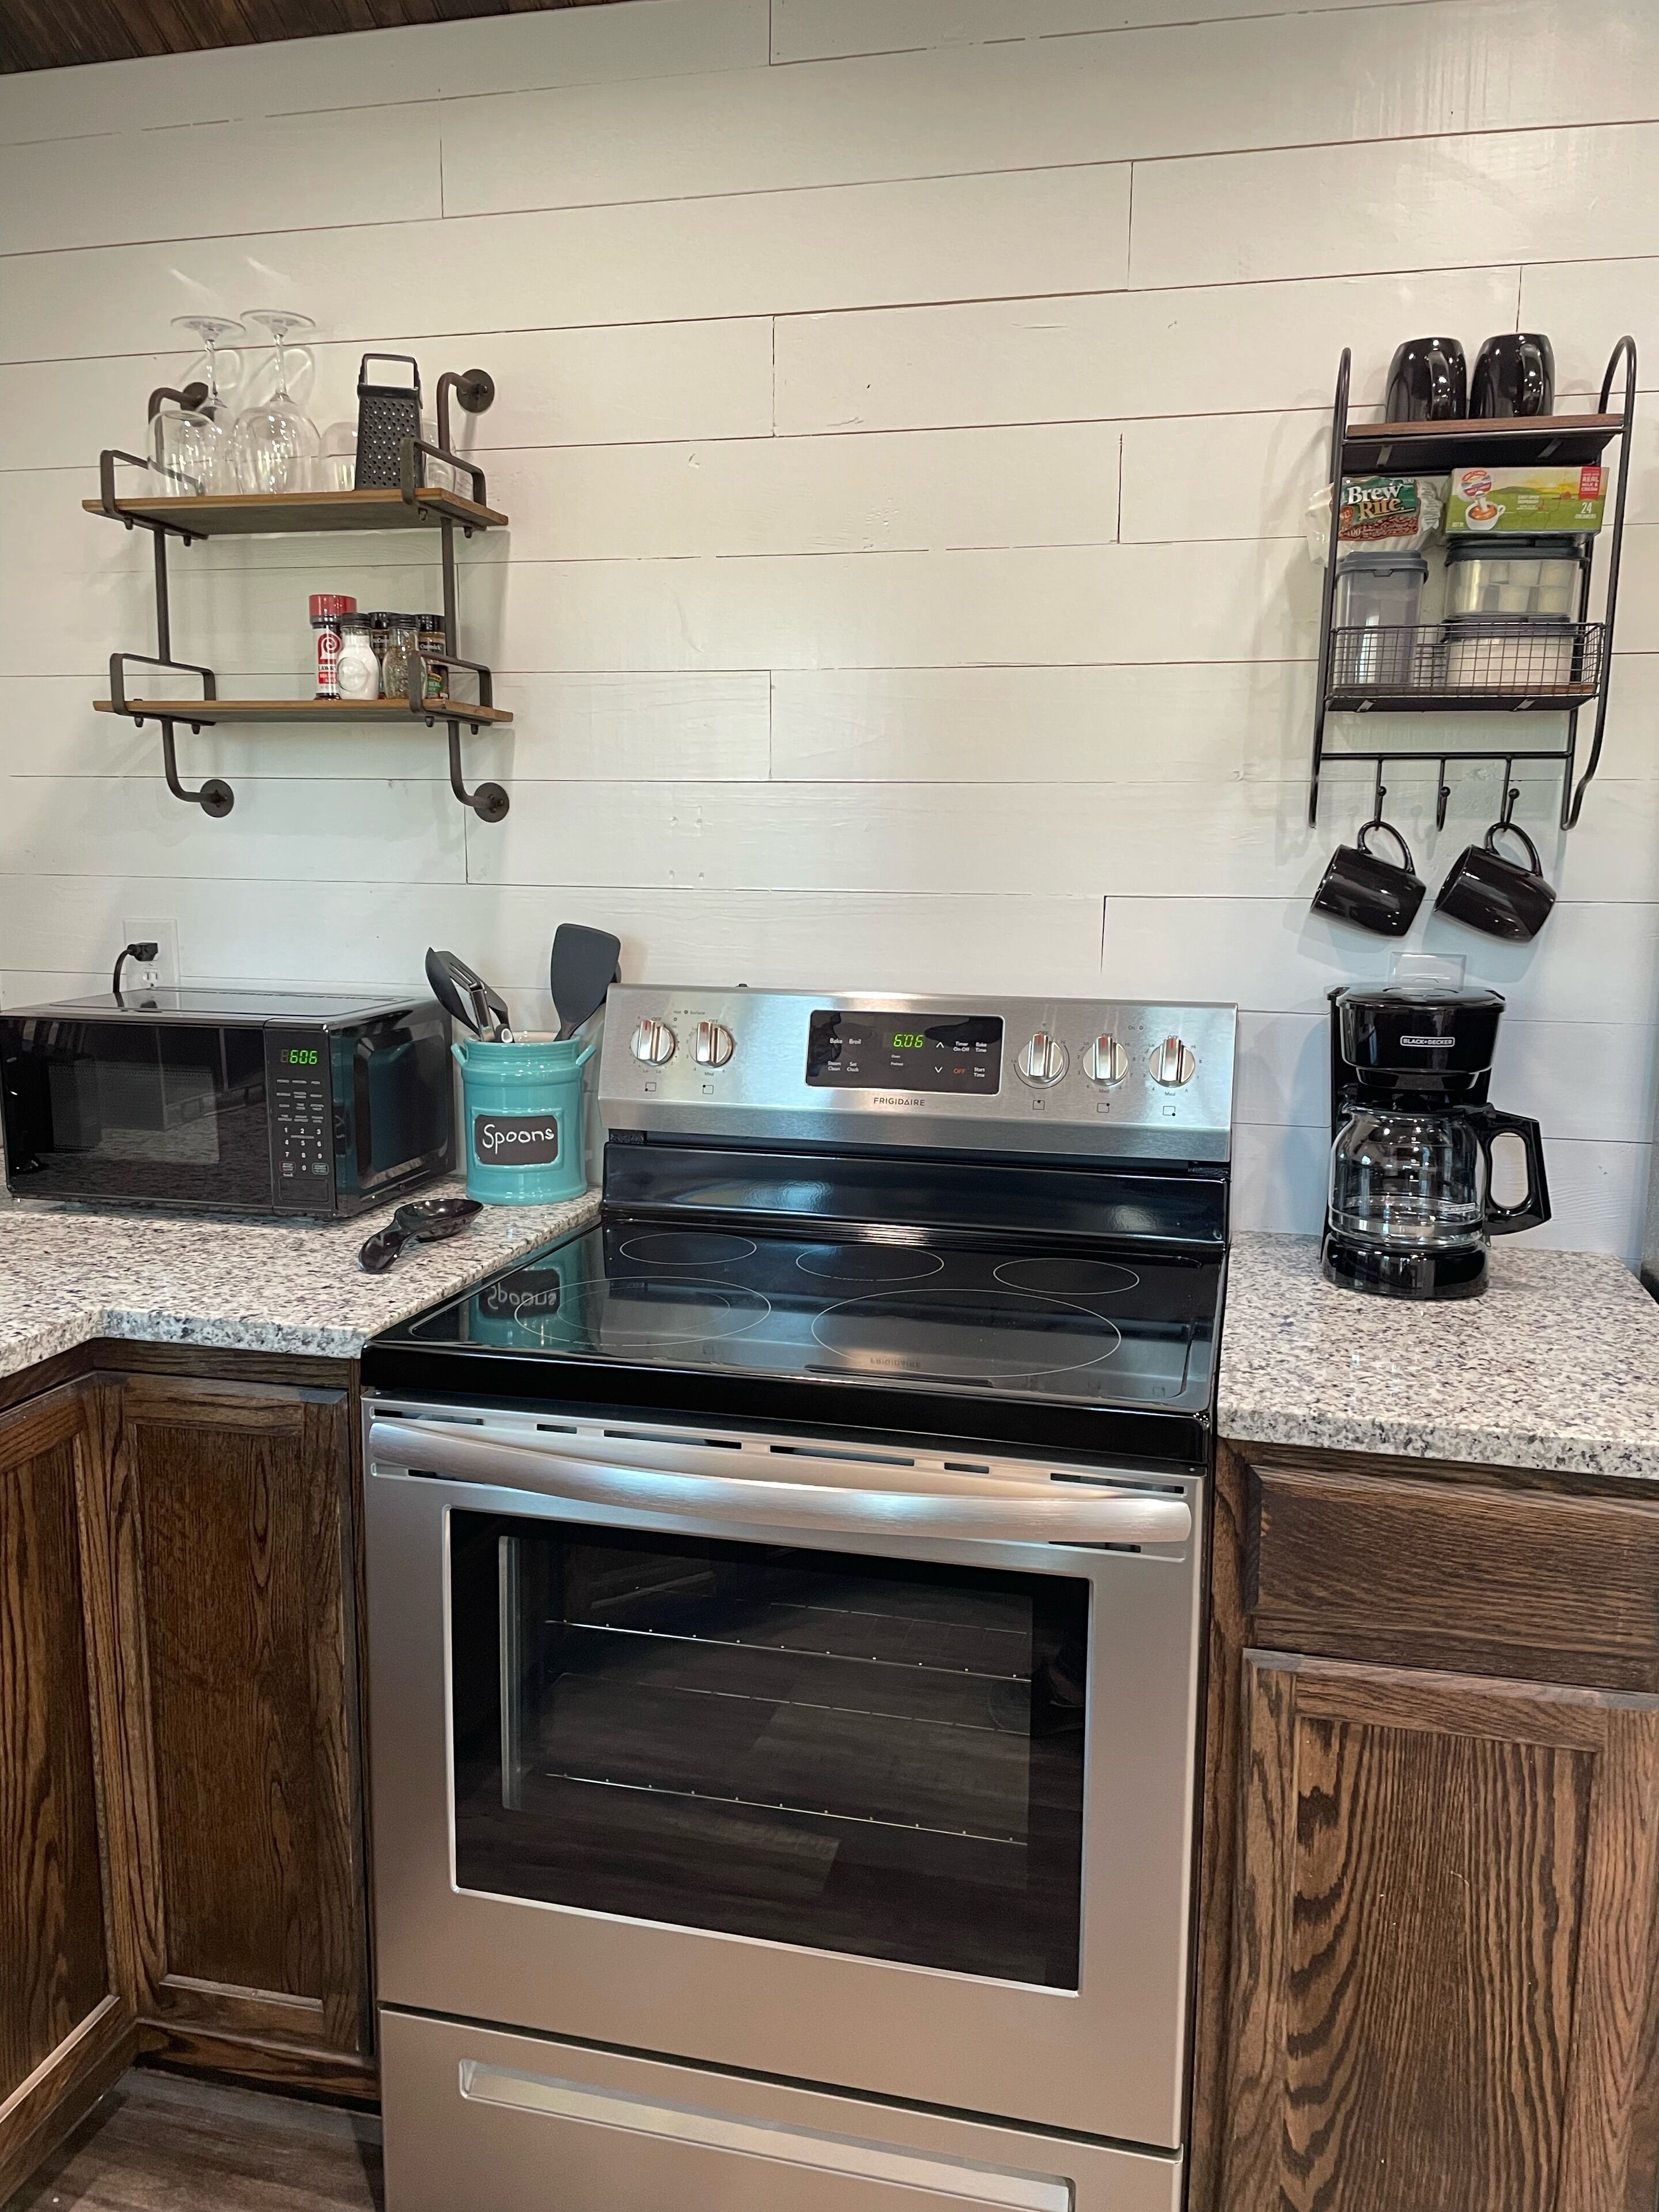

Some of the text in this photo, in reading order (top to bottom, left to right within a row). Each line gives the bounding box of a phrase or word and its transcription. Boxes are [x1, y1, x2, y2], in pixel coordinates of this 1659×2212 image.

[1347, 483, 1404, 505] Brew
[1581, 502, 1592, 514] 24
[874, 1097, 925, 1106] FRIGIDAIRE
[482, 1123, 554, 1154] Spoons
